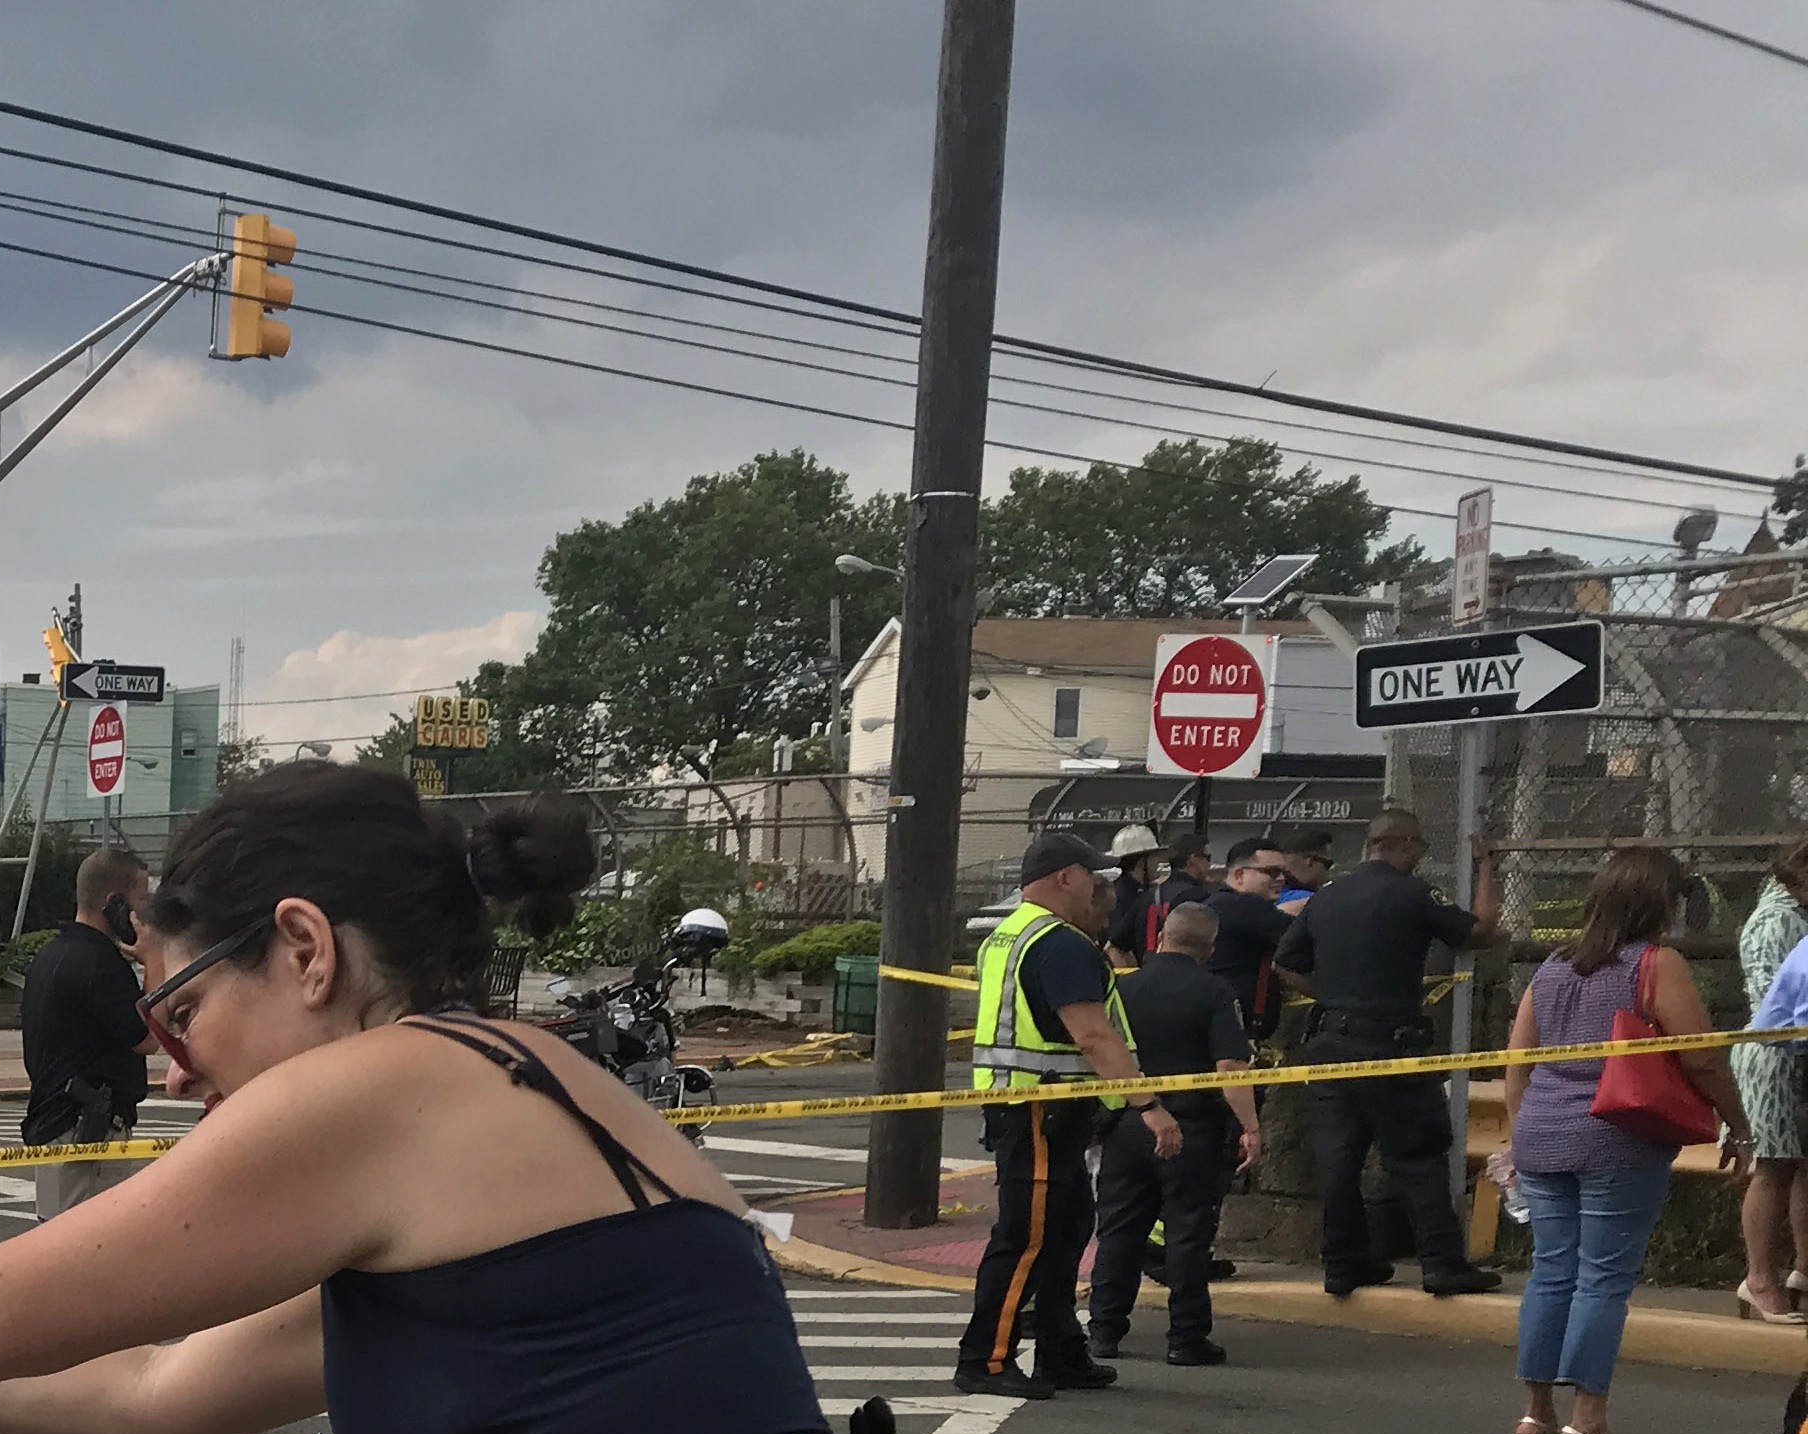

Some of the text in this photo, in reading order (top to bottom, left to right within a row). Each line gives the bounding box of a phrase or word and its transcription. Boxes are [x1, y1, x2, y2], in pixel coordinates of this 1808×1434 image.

[95, 673, 155, 692] ONE WAY
[1172, 664, 1251, 686] DO NOT
[1379, 656, 1525, 701] ONE WAY
[423, 700, 487, 719] USED
[94, 720, 120, 740] DO NOT
[422, 725, 486, 745] CARS
[1170, 725, 1241, 747] ENTER
[95, 761, 117, 779] ENTER
[415, 770, 441, 780] AUTO
